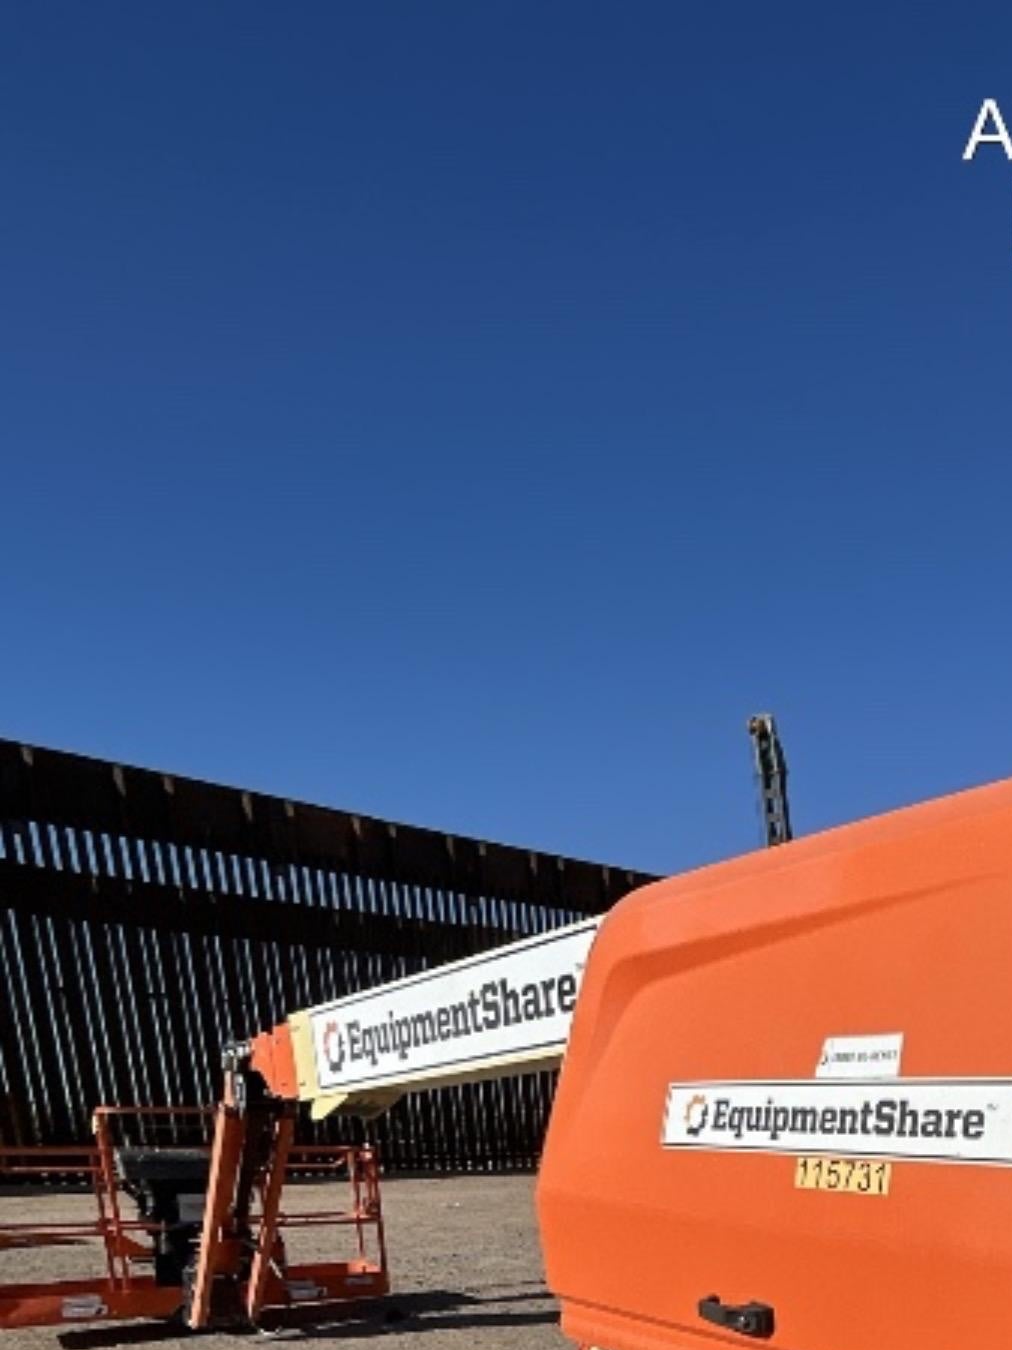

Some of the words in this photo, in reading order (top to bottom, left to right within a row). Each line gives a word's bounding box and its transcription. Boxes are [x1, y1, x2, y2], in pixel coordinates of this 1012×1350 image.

[346, 973, 576, 1066] EquipmentShare
[711, 1095, 985, 1141] EquipmentShare
[799, 1158, 886, 1193] 115731
